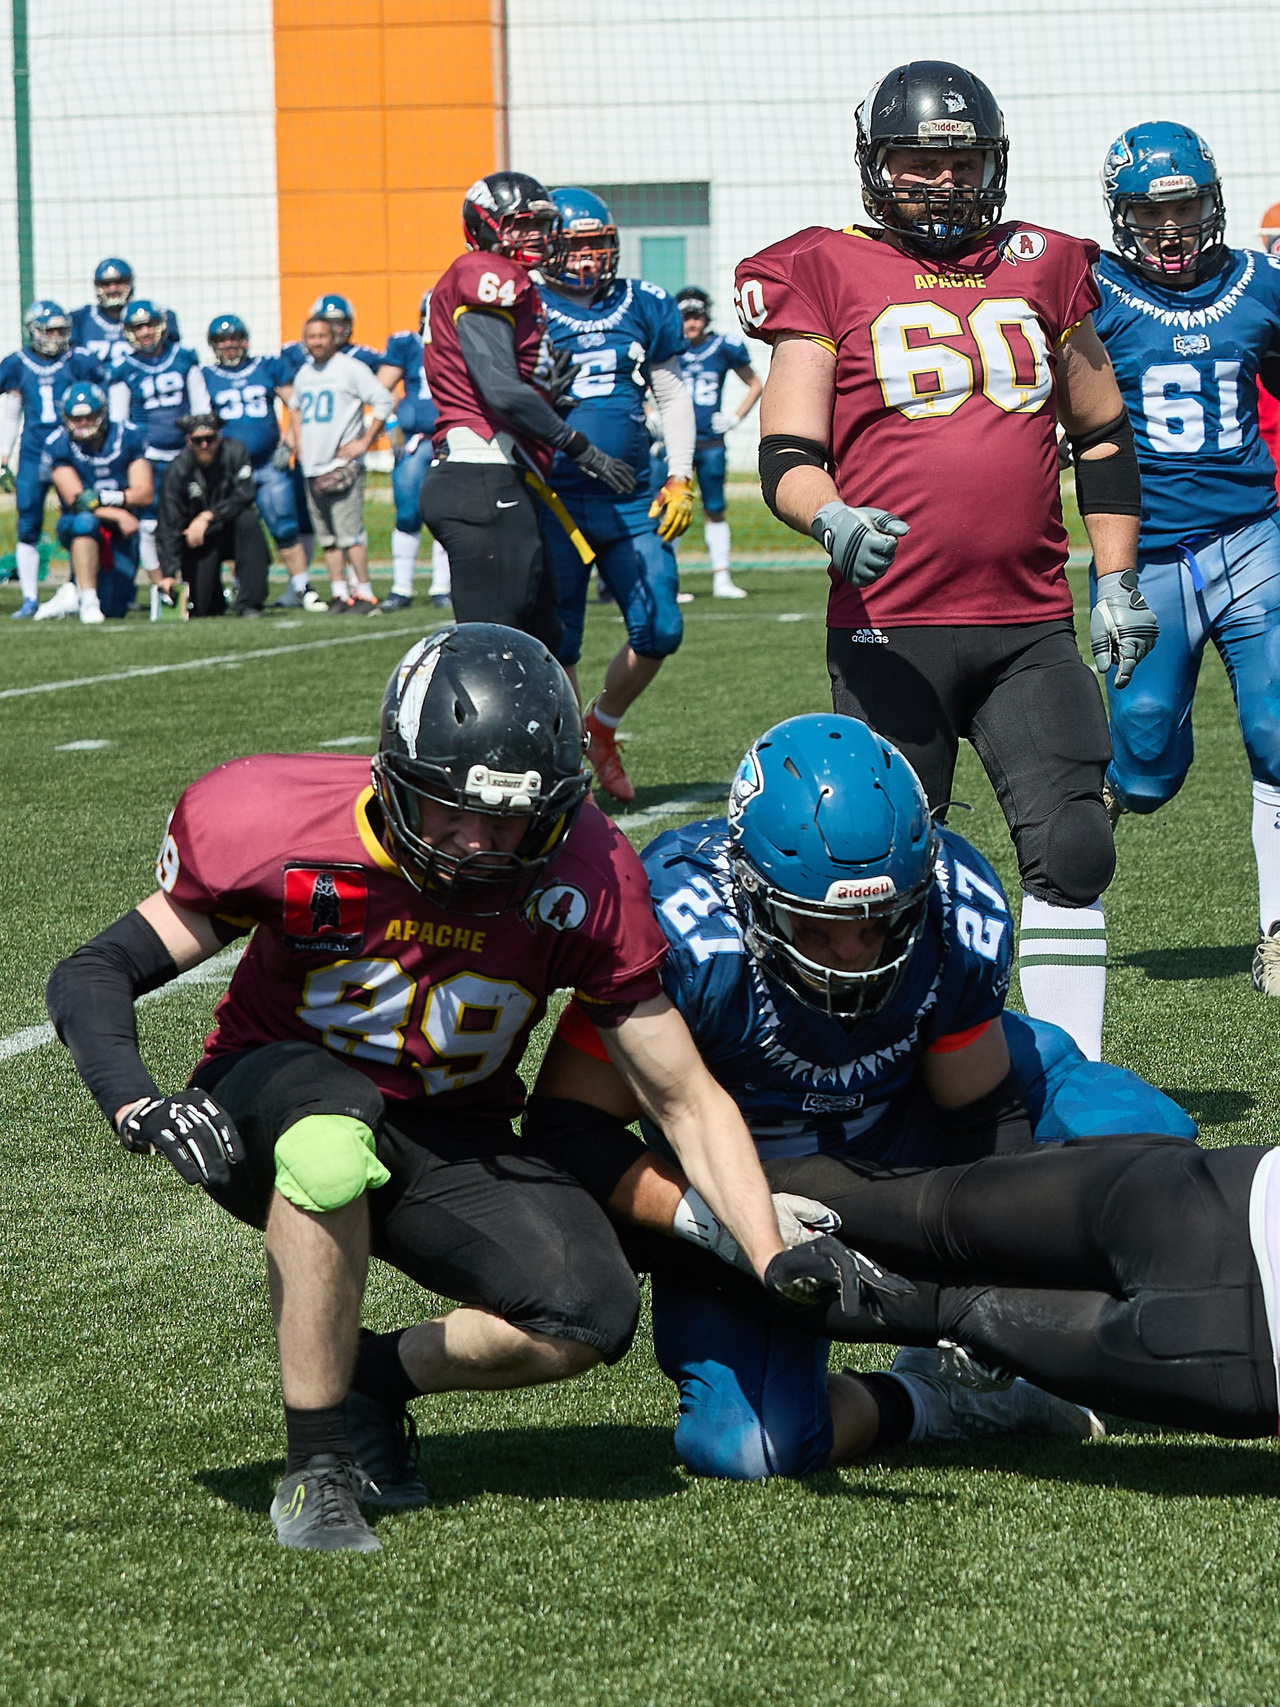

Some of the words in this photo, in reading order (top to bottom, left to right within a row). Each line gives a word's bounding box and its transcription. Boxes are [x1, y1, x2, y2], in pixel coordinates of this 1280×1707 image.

[1159, 178, 1185, 188] Riddell
[477, 272, 516, 306] 64
[914, 273, 987, 290] APACHE
[870, 297, 1054, 421] 60
[301, 390, 334, 423] 20
[1141, 359, 1244, 452] 61
[852, 634, 889, 644] adidas
[837, 881, 890, 900] Riddell
[660, 876, 746, 966] 27
[953, 859, 1008, 962] 27
[384, 918, 487, 955] APACHE
[296, 957, 537, 1097] 89
